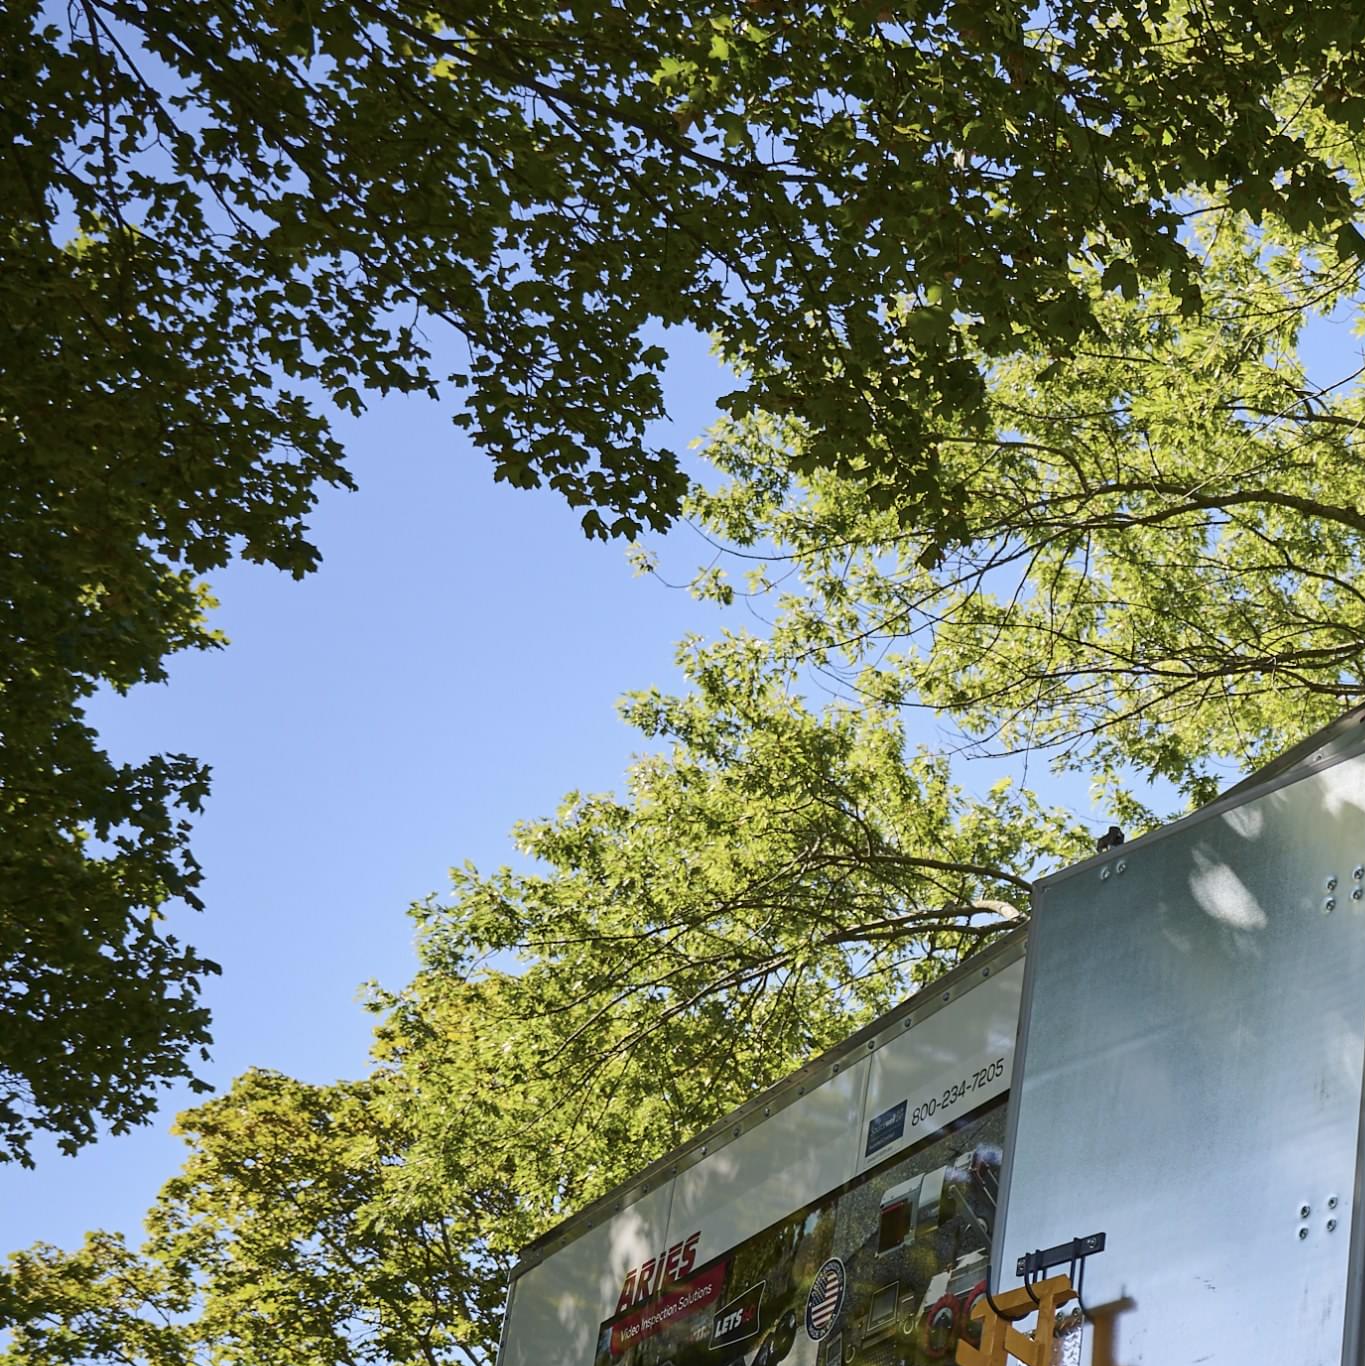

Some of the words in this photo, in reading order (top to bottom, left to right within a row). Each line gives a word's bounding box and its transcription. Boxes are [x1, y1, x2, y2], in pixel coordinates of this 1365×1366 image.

[911, 1058, 1005, 1126] 800-234-7205
[615, 1231, 701, 1315] ARIES
[620, 1326, 640, 1342] Video
[641, 1302, 678, 1331] Inspection
[678, 1284, 713, 1311] Solutions
[714, 1308, 744, 1338] LETS
